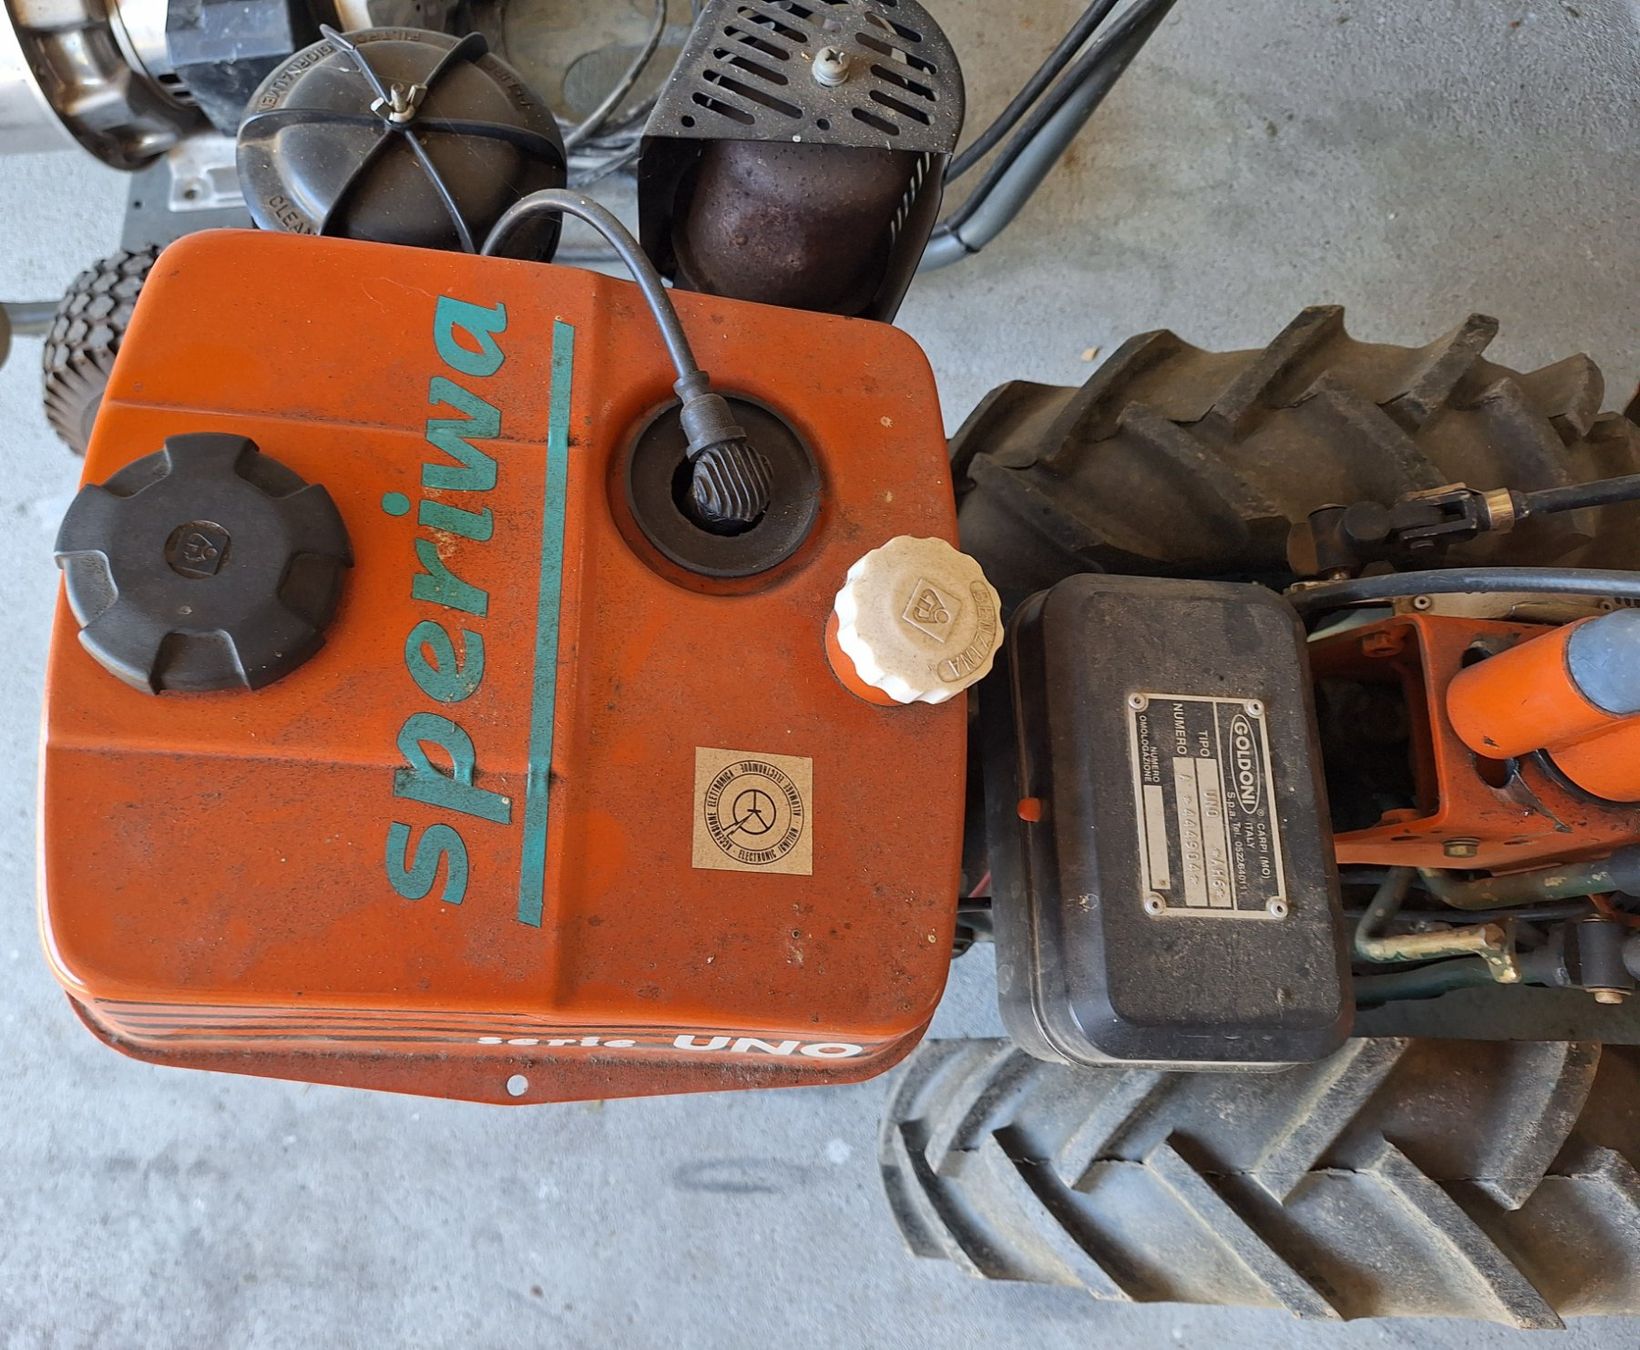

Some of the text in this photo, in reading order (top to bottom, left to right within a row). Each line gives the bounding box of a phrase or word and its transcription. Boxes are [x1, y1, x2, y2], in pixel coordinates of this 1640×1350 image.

[269, 195, 318, 236] CLEA
[381, 295, 512, 905] speriwa
[948, 590, 995, 677] BENZINA
[1139, 715, 1153, 782] OMOLOGAZIONE
[1172, 703, 1188, 755] NUMERO
[1198, 730, 1210, 757] TIPO
[1150, 746, 1160, 783] NUMERO
[1235, 722, 1256, 804] GOLDONI
[707, 769, 735, 851] ACCENSIONE ELETTRONICA
[1203, 789, 1219, 818] UNO
[738, 827, 799, 862] ELECTRONIC IGNITION
[1233, 822, 1241, 838] Tel.
[1245, 822, 1255, 849] ITALY
[1257, 823, 1271, 879] CARPI (MO)
[477, 1034, 865, 1059] serie UNO
